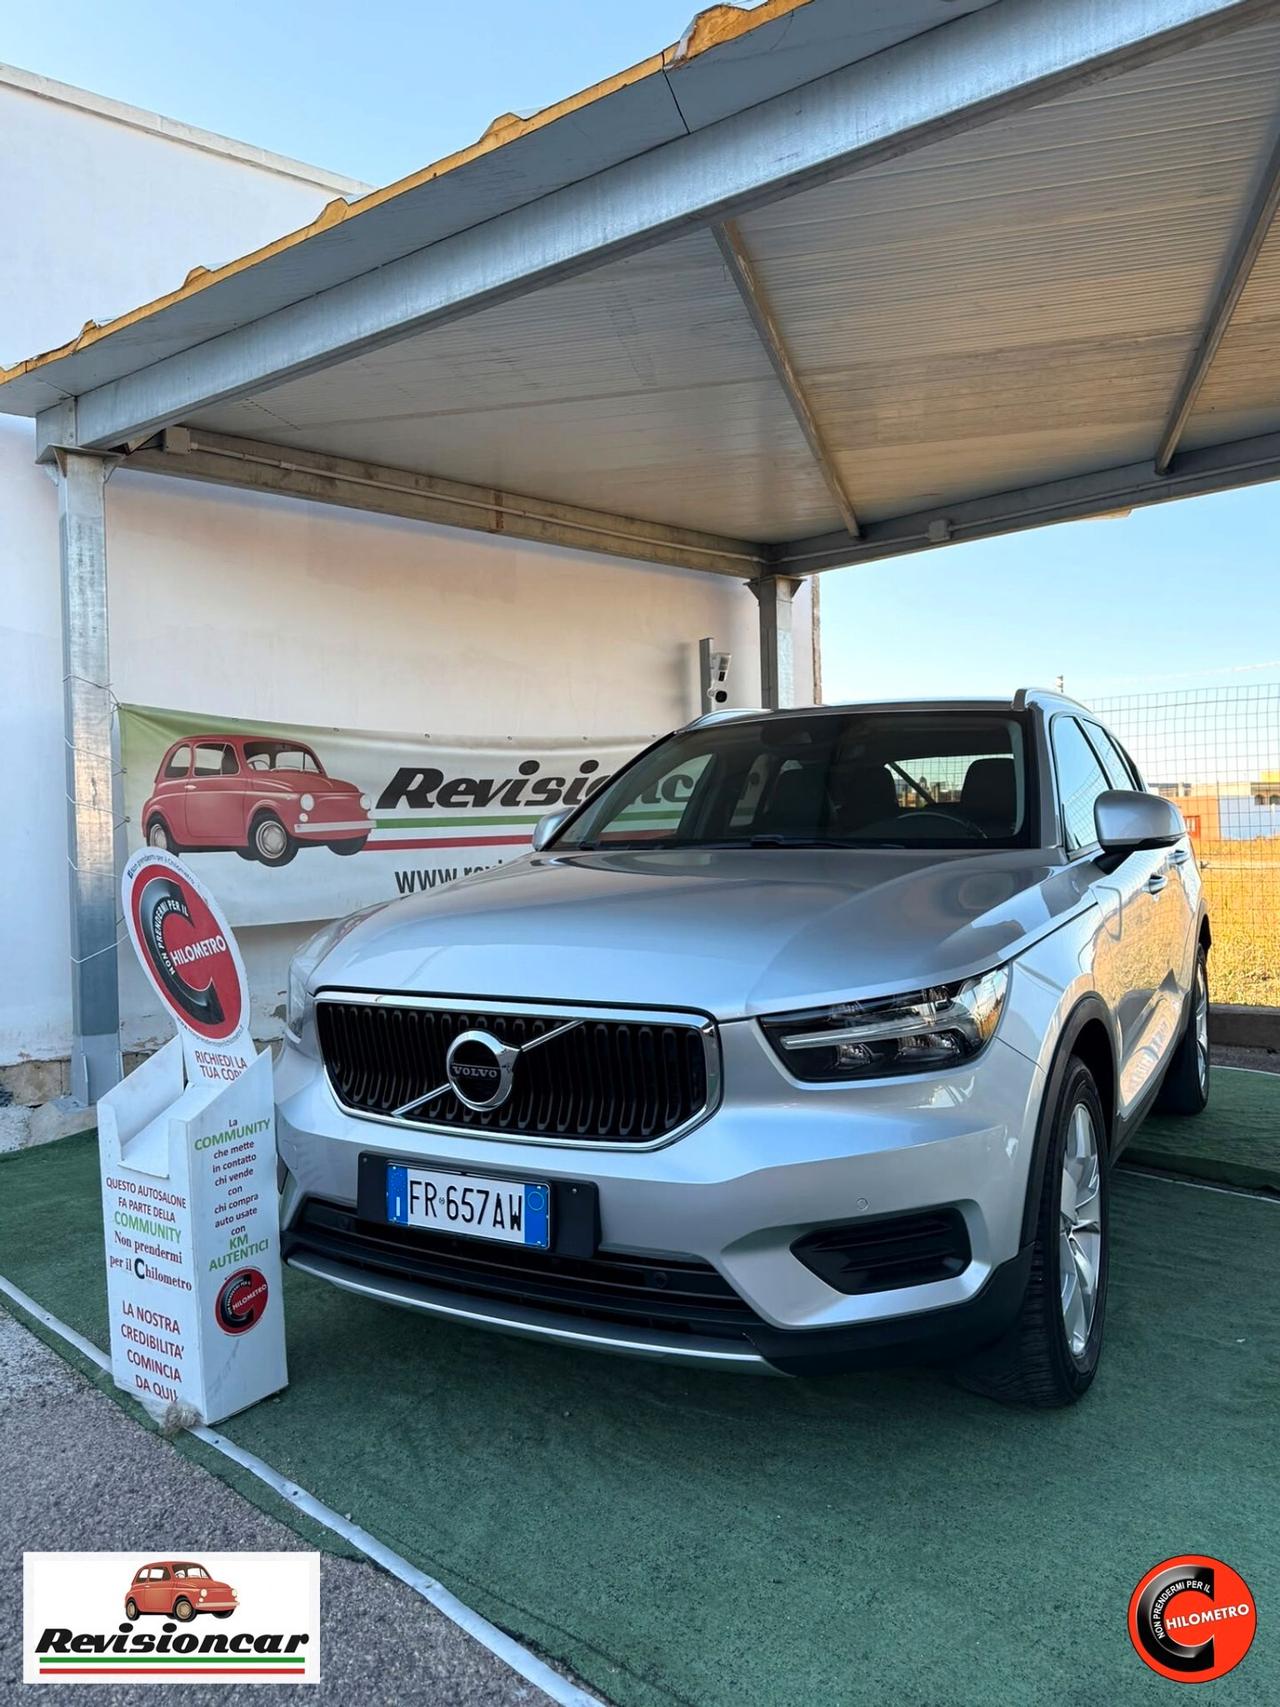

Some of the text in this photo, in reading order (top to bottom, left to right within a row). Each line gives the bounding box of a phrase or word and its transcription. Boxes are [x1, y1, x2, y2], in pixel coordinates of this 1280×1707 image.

[167, 899, 181, 912] PER
[162, 953, 176, 975] NON
[195, 1050, 248, 1070] RICHIEDI LA
[199, 1065, 242, 1081] TUA COP
[452, 1065, 498, 1079] VOLVO
[229, 1119, 238, 1128] La
[194, 1118, 271, 1151] COMMUNITY
[213, 1141, 255, 1160] che mette
[212, 1154, 257, 1174] in contatto
[214, 1168, 254, 1187] chi vende
[106, 1177, 186, 1209] QUESTO AUTOSALONE
[228, 1185, 243, 1196] con
[118, 1196, 176, 1223] FA PARTE DELLA
[214, 1193, 259, 1215] chi compra
[114, 1211, 182, 1244] COMMUNITY
[215, 1207, 258, 1229] auto usate
[231, 1225, 246, 1236] con
[114, 1230, 183, 1264] Non prendermi
[229, 1234, 249, 1251] KM
[109, 1256, 124, 1268] per
[125, 1257, 133, 1272] il
[209, 1238, 269, 1272] AUTENTICI
[122, 1300, 181, 1335] LA NOSTRA
[121, 1323, 185, 1360] CREDIBILITA'
[127, 1349, 182, 1383] COMINCIA
[135, 1374, 151, 1393] DA
